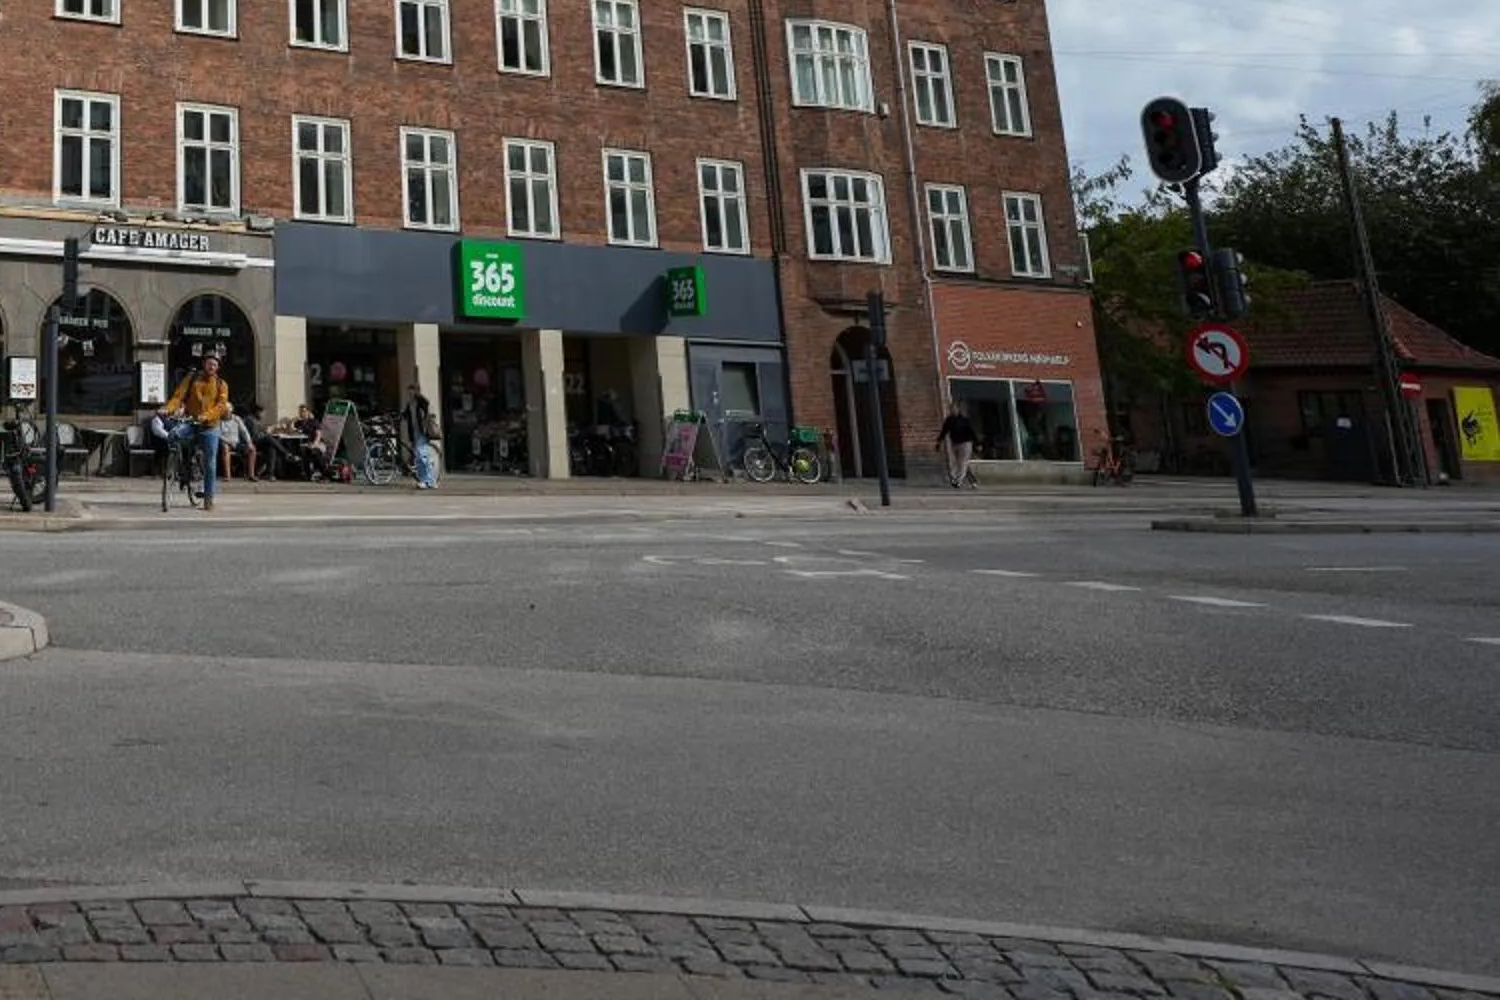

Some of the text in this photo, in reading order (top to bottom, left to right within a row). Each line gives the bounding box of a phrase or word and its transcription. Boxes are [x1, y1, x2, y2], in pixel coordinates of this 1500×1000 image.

[95, 227, 210, 250] CAFE AMAGER
[469, 261, 516, 293] 365
[671, 279, 694, 300] 365
[471, 294, 516, 308] discount
